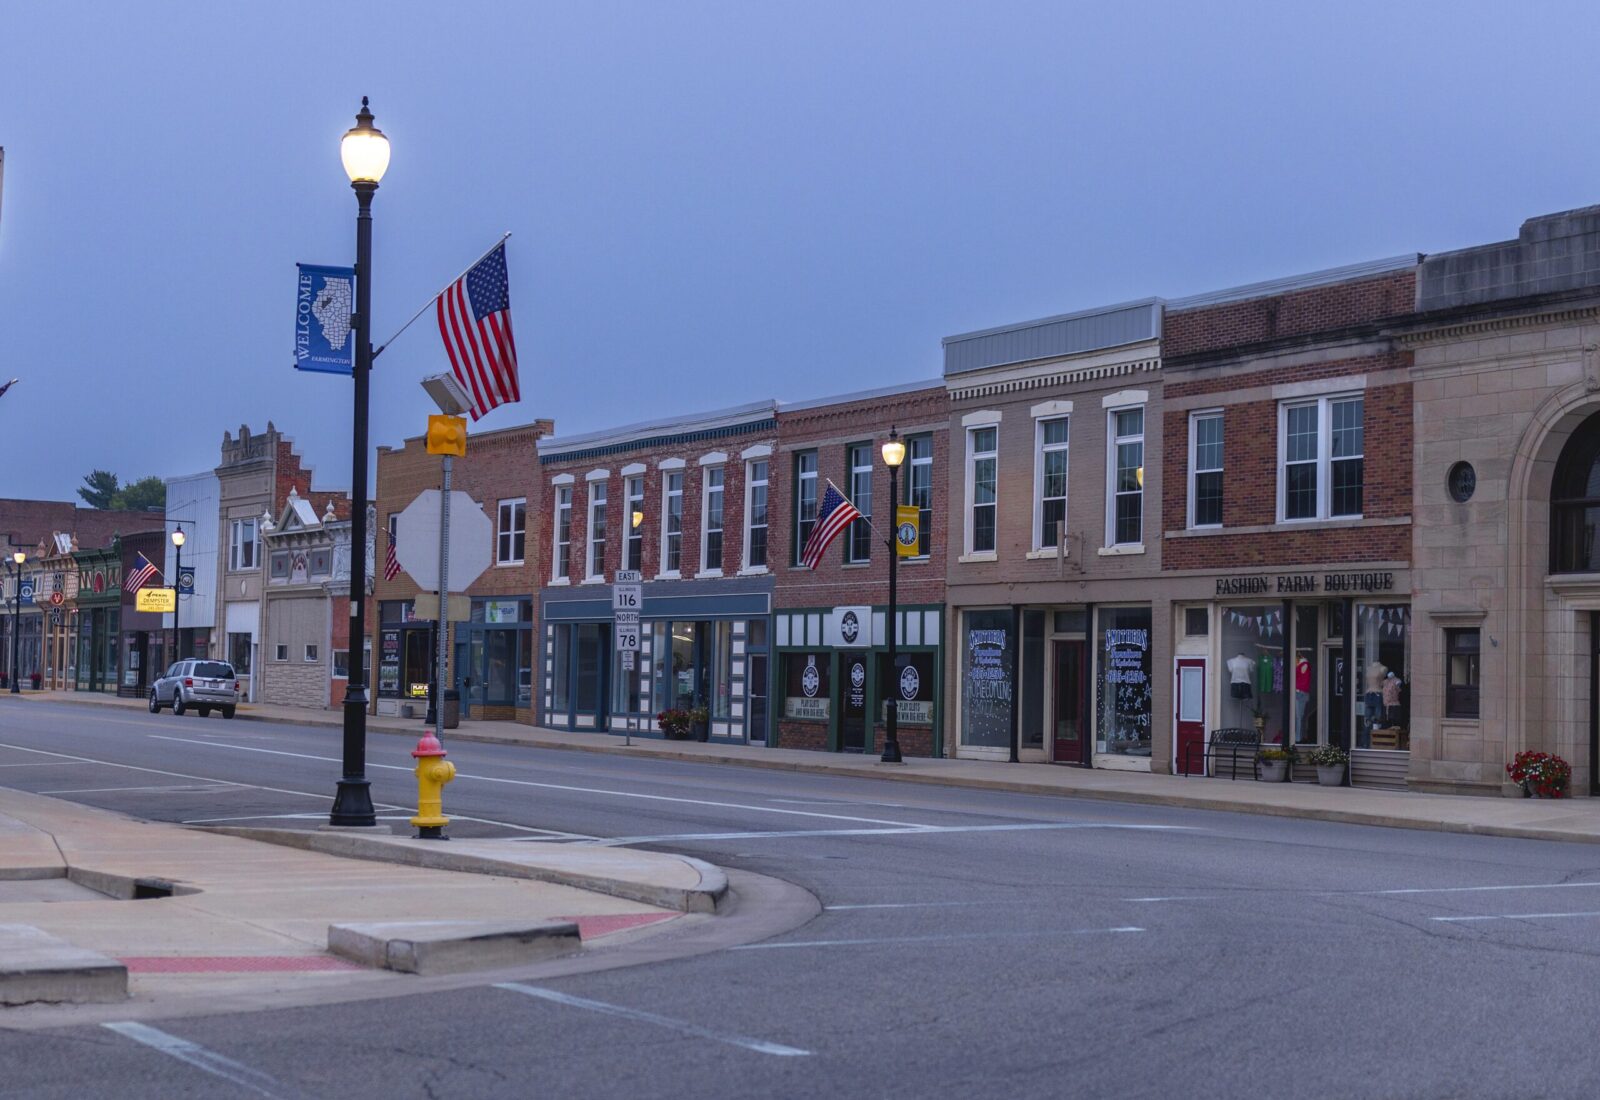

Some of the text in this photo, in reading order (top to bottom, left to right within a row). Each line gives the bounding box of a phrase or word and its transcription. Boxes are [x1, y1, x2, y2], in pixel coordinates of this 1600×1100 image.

[298, 274, 312, 360] WELCOME
[312, 356, 350, 364] FARMINGTON
[618, 572, 635, 580] EAST
[1216, 573, 1393, 595] FASHION FARM BOUTIQUE
[618, 594, 636, 606] 116
[616, 614, 639, 622] NORTH
[619, 635, 636, 647] 78
[969, 629, 1006, 650] SMITHERS
[1106, 629, 1148, 650] SMITHERS
[967, 680, 1012, 702] HOMECOMING
[899, 702, 920, 712] PLAY SLOTS
[901, 712, 909, 721] WIN
[916, 712, 926, 722] HERE
